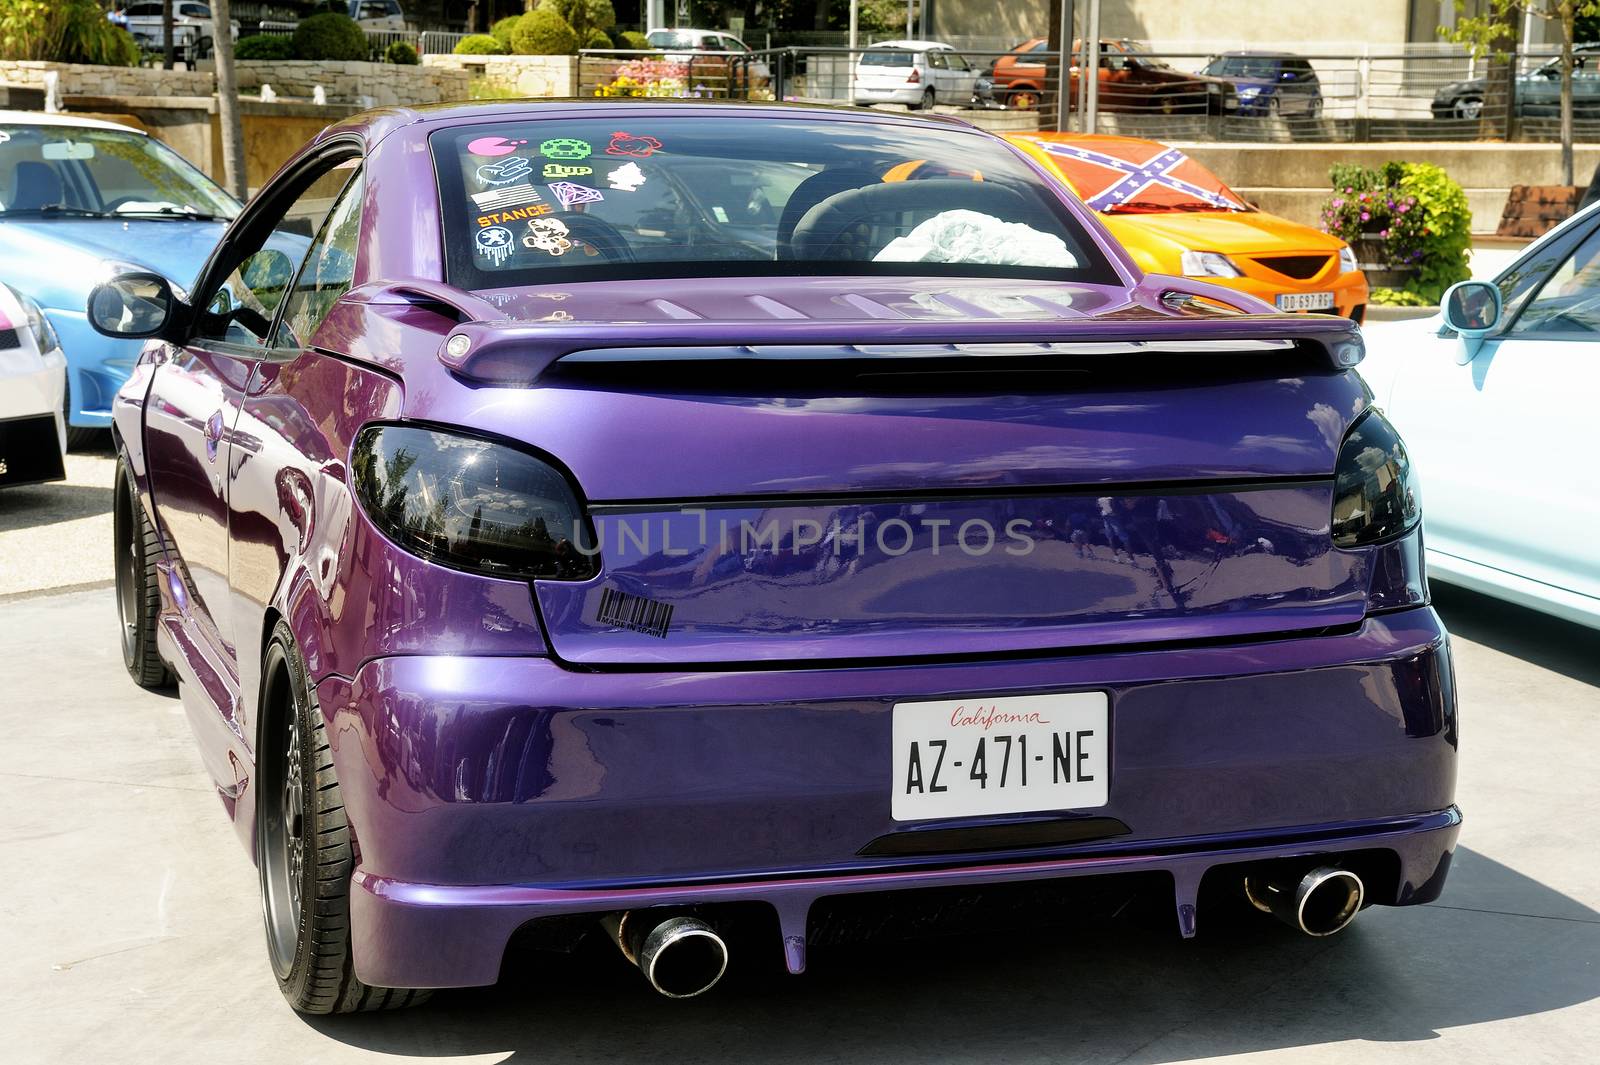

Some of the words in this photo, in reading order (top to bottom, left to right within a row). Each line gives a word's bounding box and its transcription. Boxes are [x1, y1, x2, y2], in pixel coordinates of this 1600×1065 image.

[478, 203, 554, 228] STANCE
[601, 616, 625, 628] MADE
[626, 622, 637, 632] IN
[637, 626, 663, 638] SPAIN
[950, 705, 1050, 730] California
[906, 730, 1094, 794] AZ-471-NE
